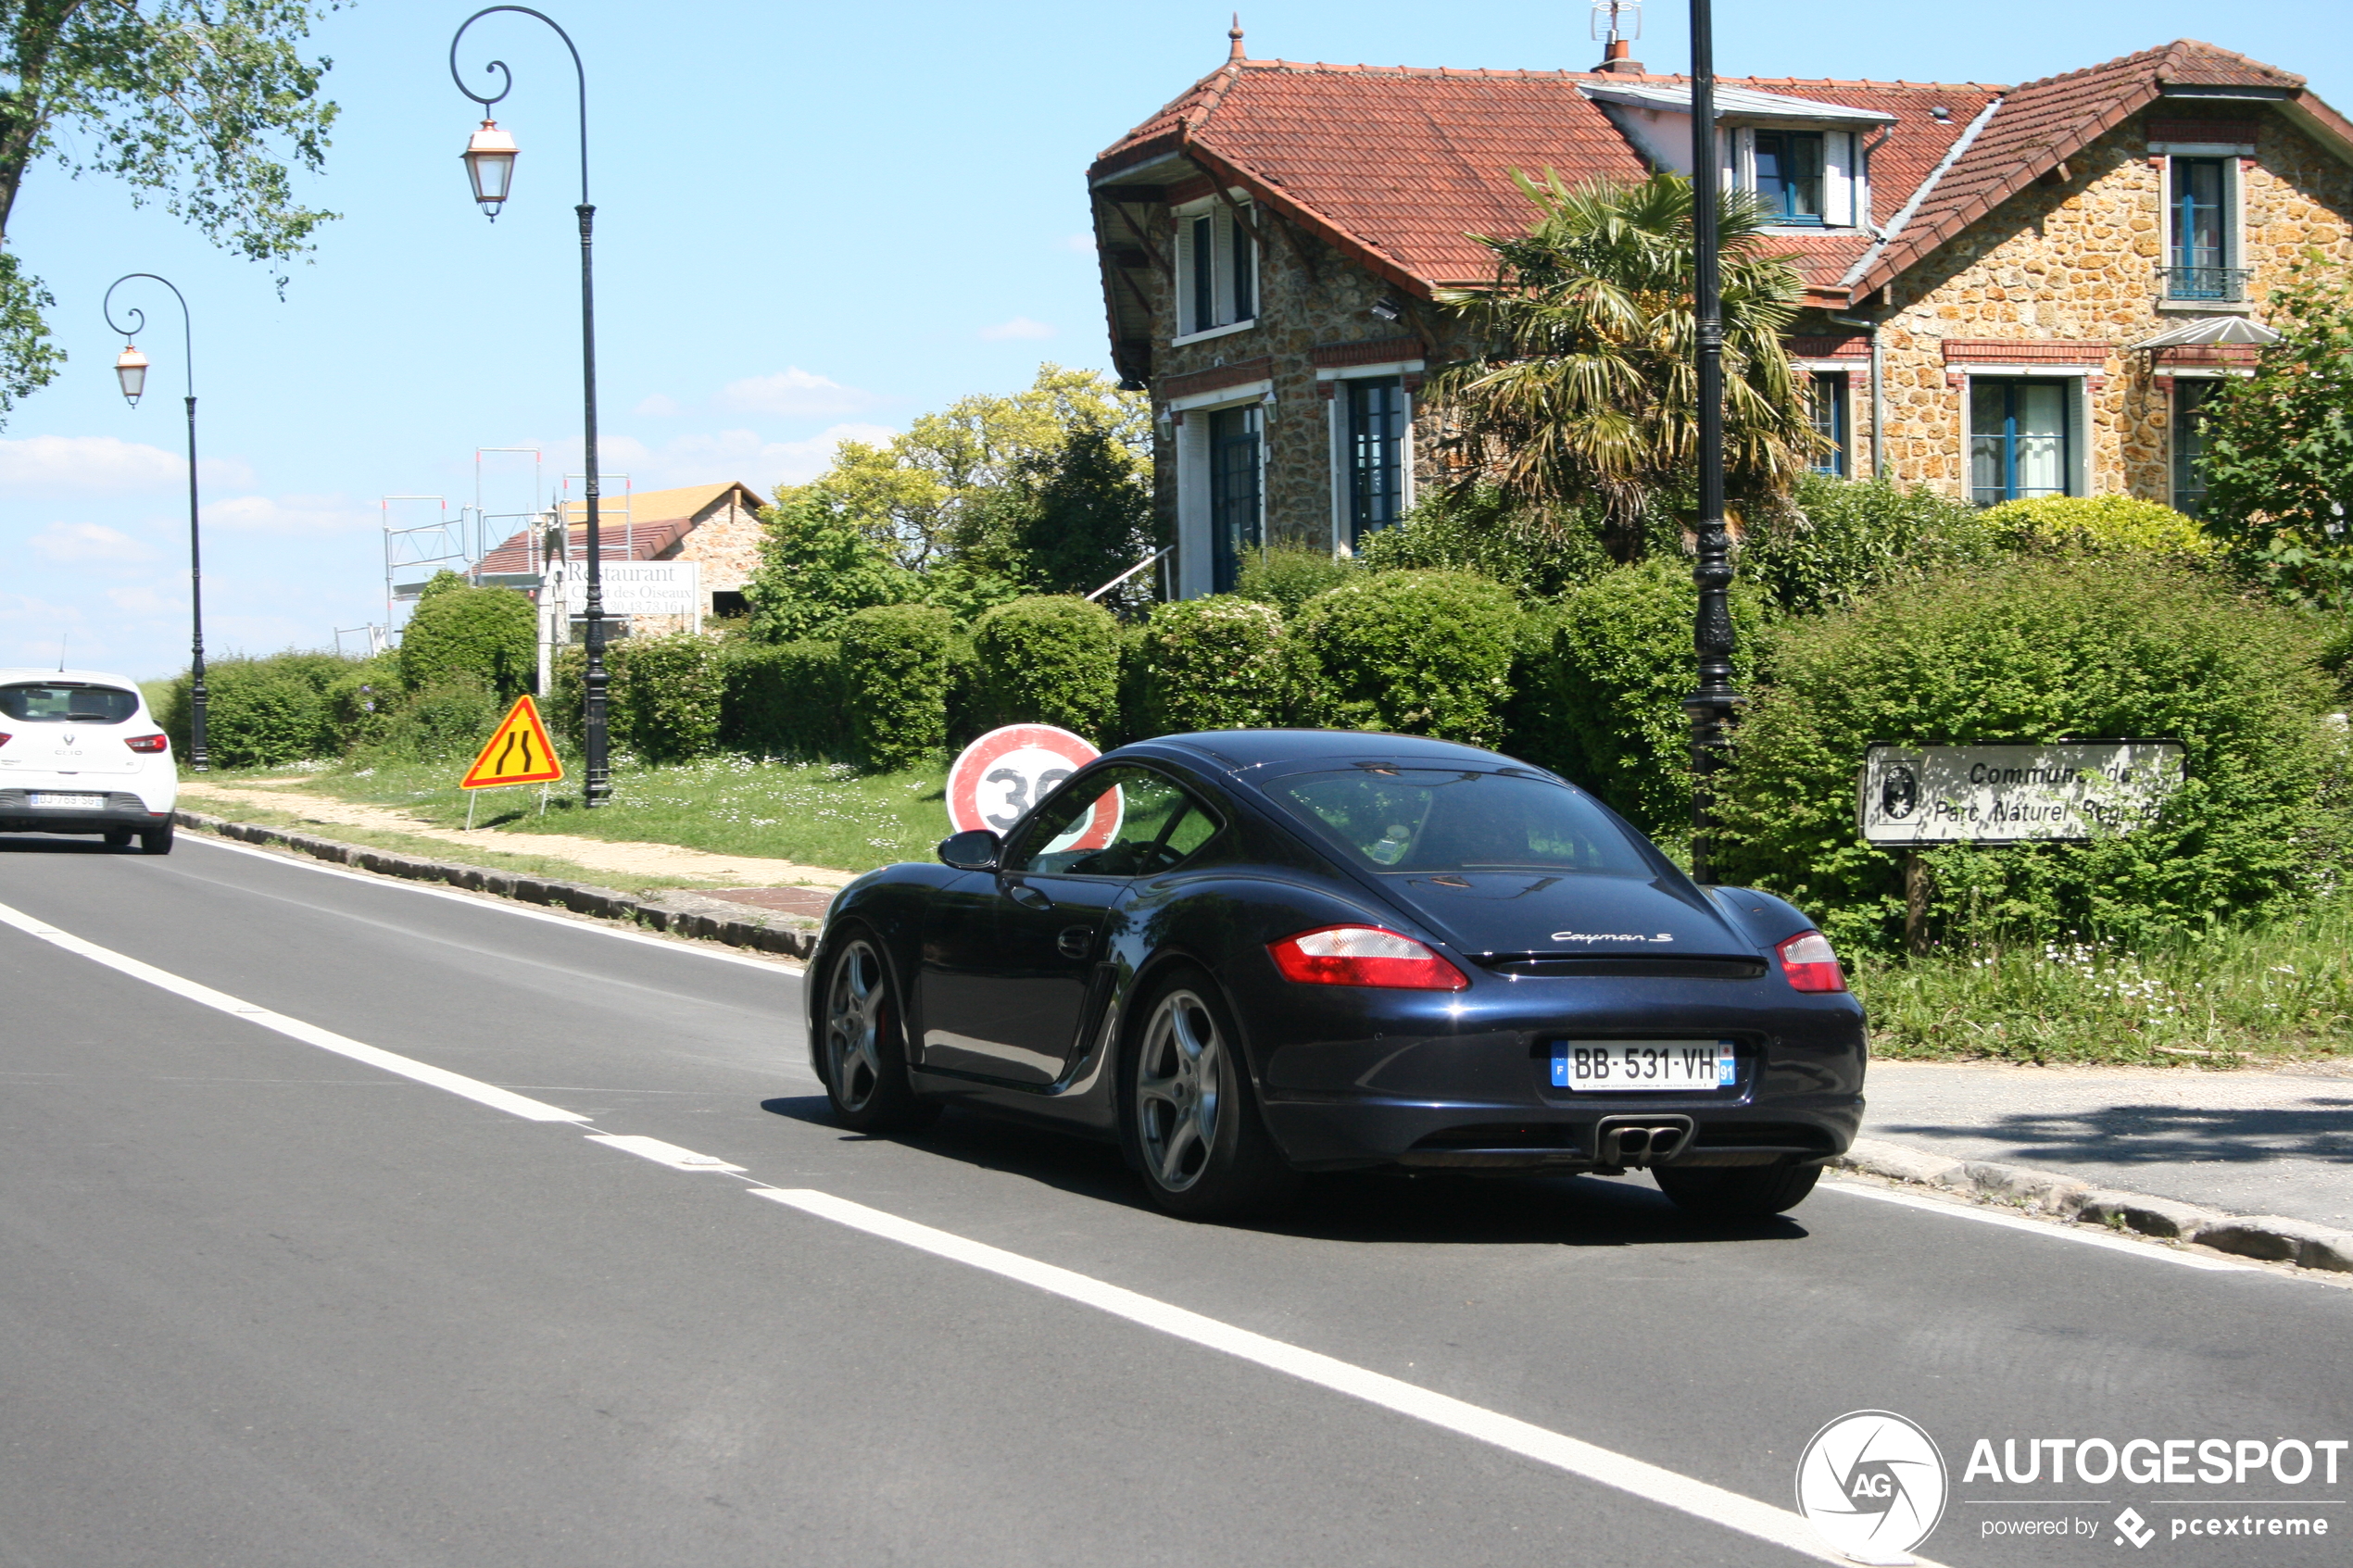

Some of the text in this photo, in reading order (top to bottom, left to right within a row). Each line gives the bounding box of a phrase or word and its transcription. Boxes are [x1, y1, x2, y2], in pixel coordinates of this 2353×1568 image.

[614, 584, 635, 598] des
[639, 584, 692, 598] Oiseaux
[1933, 800, 1980, 822] Parc
[1994, 800, 2069, 822] Naturel
[1551, 931, 1673, 944] Cayman S
[1556, 1066, 1564, 1075] F
[1719, 1065, 1733, 1081] 91
